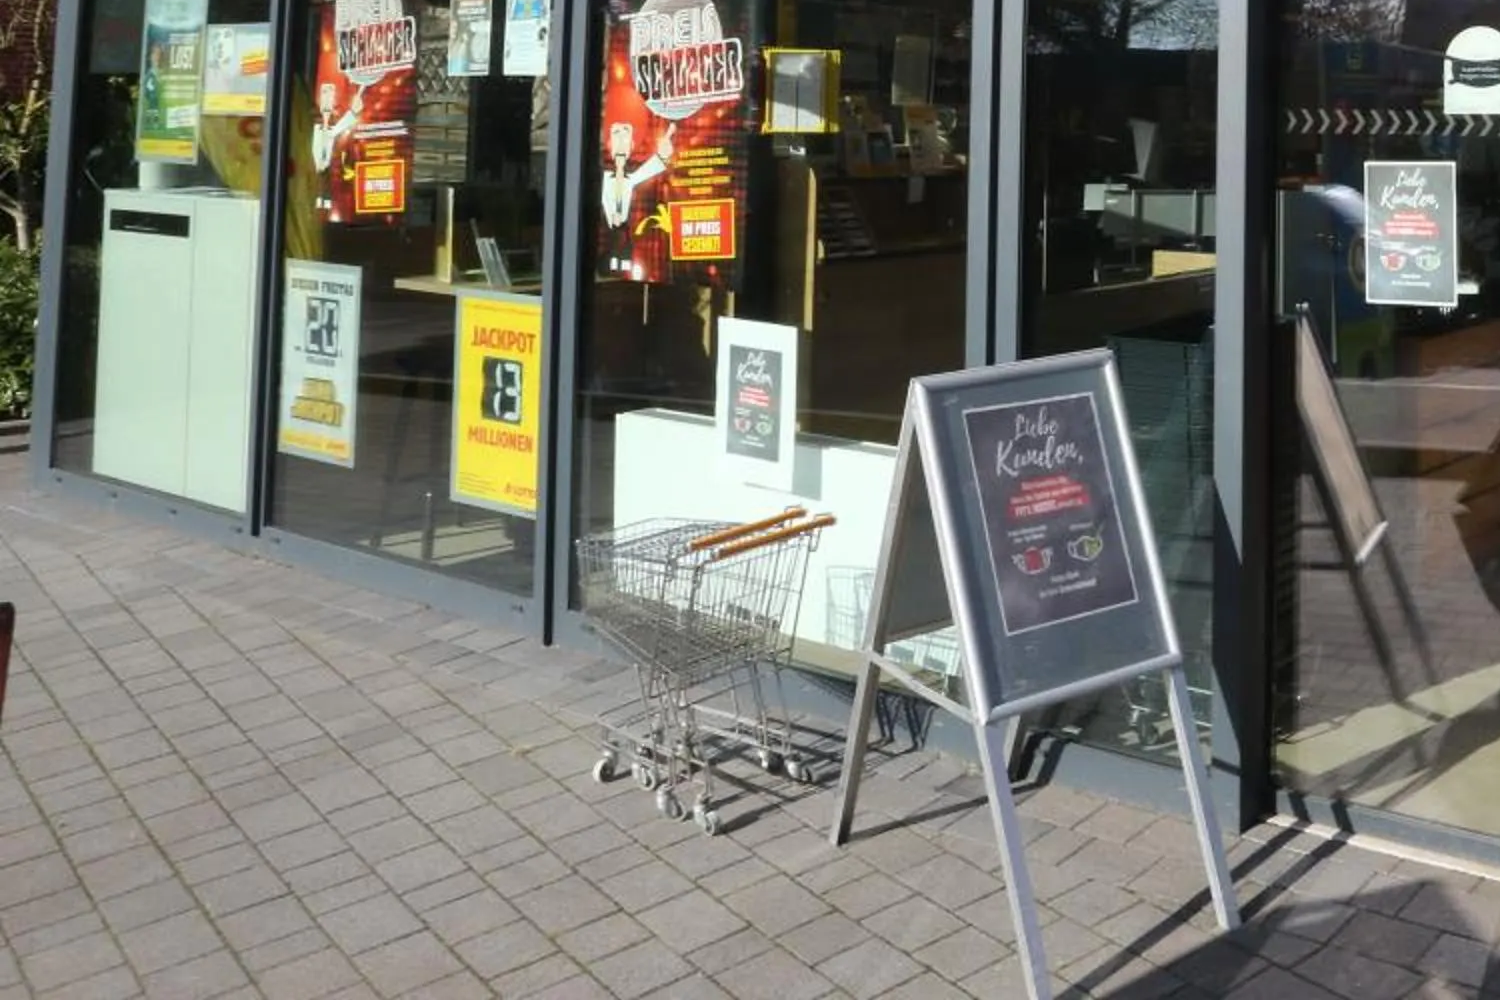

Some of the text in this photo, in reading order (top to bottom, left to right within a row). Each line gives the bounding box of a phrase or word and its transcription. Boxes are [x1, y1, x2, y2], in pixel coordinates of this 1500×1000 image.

[471, 325, 536, 355] JACKPOT
[468, 425, 533, 453] MILLIONEN
[1015, 406, 1058, 440] Liebe
[996, 436, 1083, 477] Kunden,
